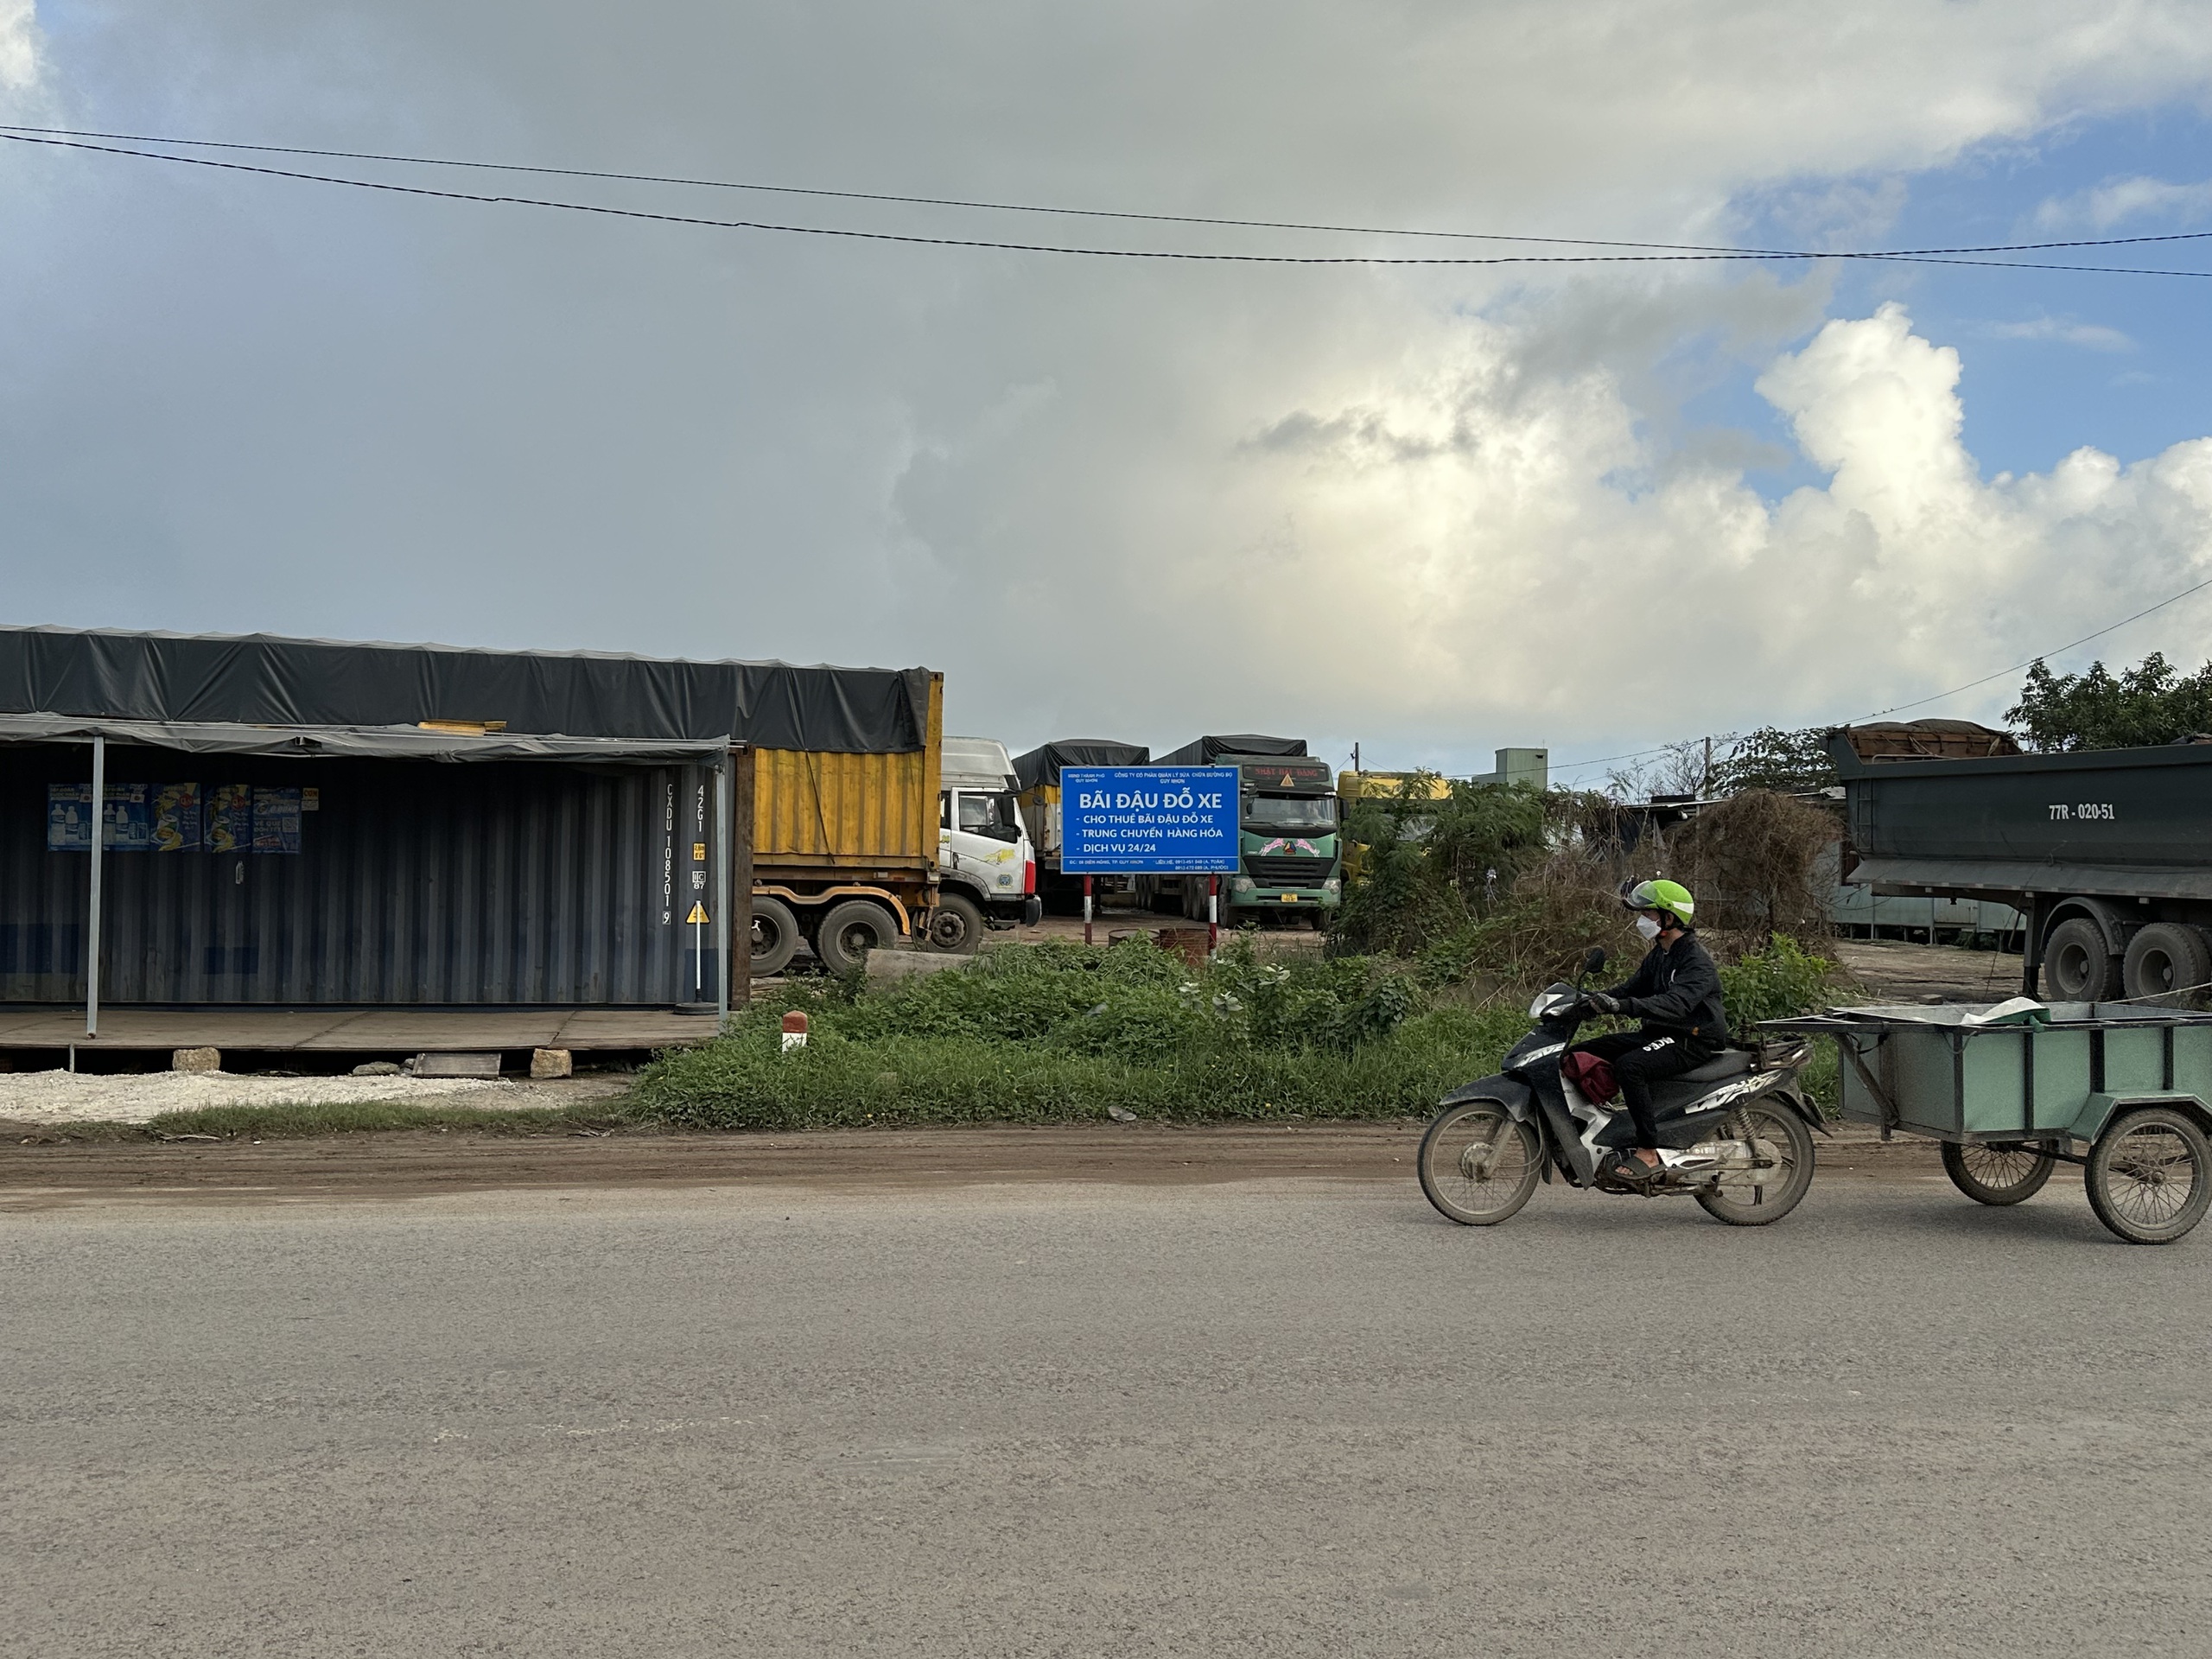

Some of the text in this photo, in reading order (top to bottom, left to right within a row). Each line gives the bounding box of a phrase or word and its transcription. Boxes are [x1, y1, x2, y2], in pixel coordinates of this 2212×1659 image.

[1080, 787, 1222, 812] BÃI ĐẬU ĐỖ XE
[1084, 815, 1106, 823] CHO
[1109, 813, 1135, 823] THUÊ
[1138, 813, 1155, 823] BÃI
[1157, 813, 1179, 825] ĐẬU
[1182, 811, 1198, 823] ĐỖ
[1200, 815, 1213, 823] XE
[2049, 804, 2069, 820] 77R
[1082, 830, 1116, 838] TRUNG
[1120, 826, 1163, 838] CHUYỂN
[1167, 827, 1198, 838] HÀNG
[1199, 827, 1223, 838] HÓA
[1084, 844, 1108, 855] DỊCH
[1111, 844, 1125, 855] VỤ
[1128, 843, 1156, 852] 24/24
[664, 835, 672, 907] 108501
[663, 911, 671, 925] 9
